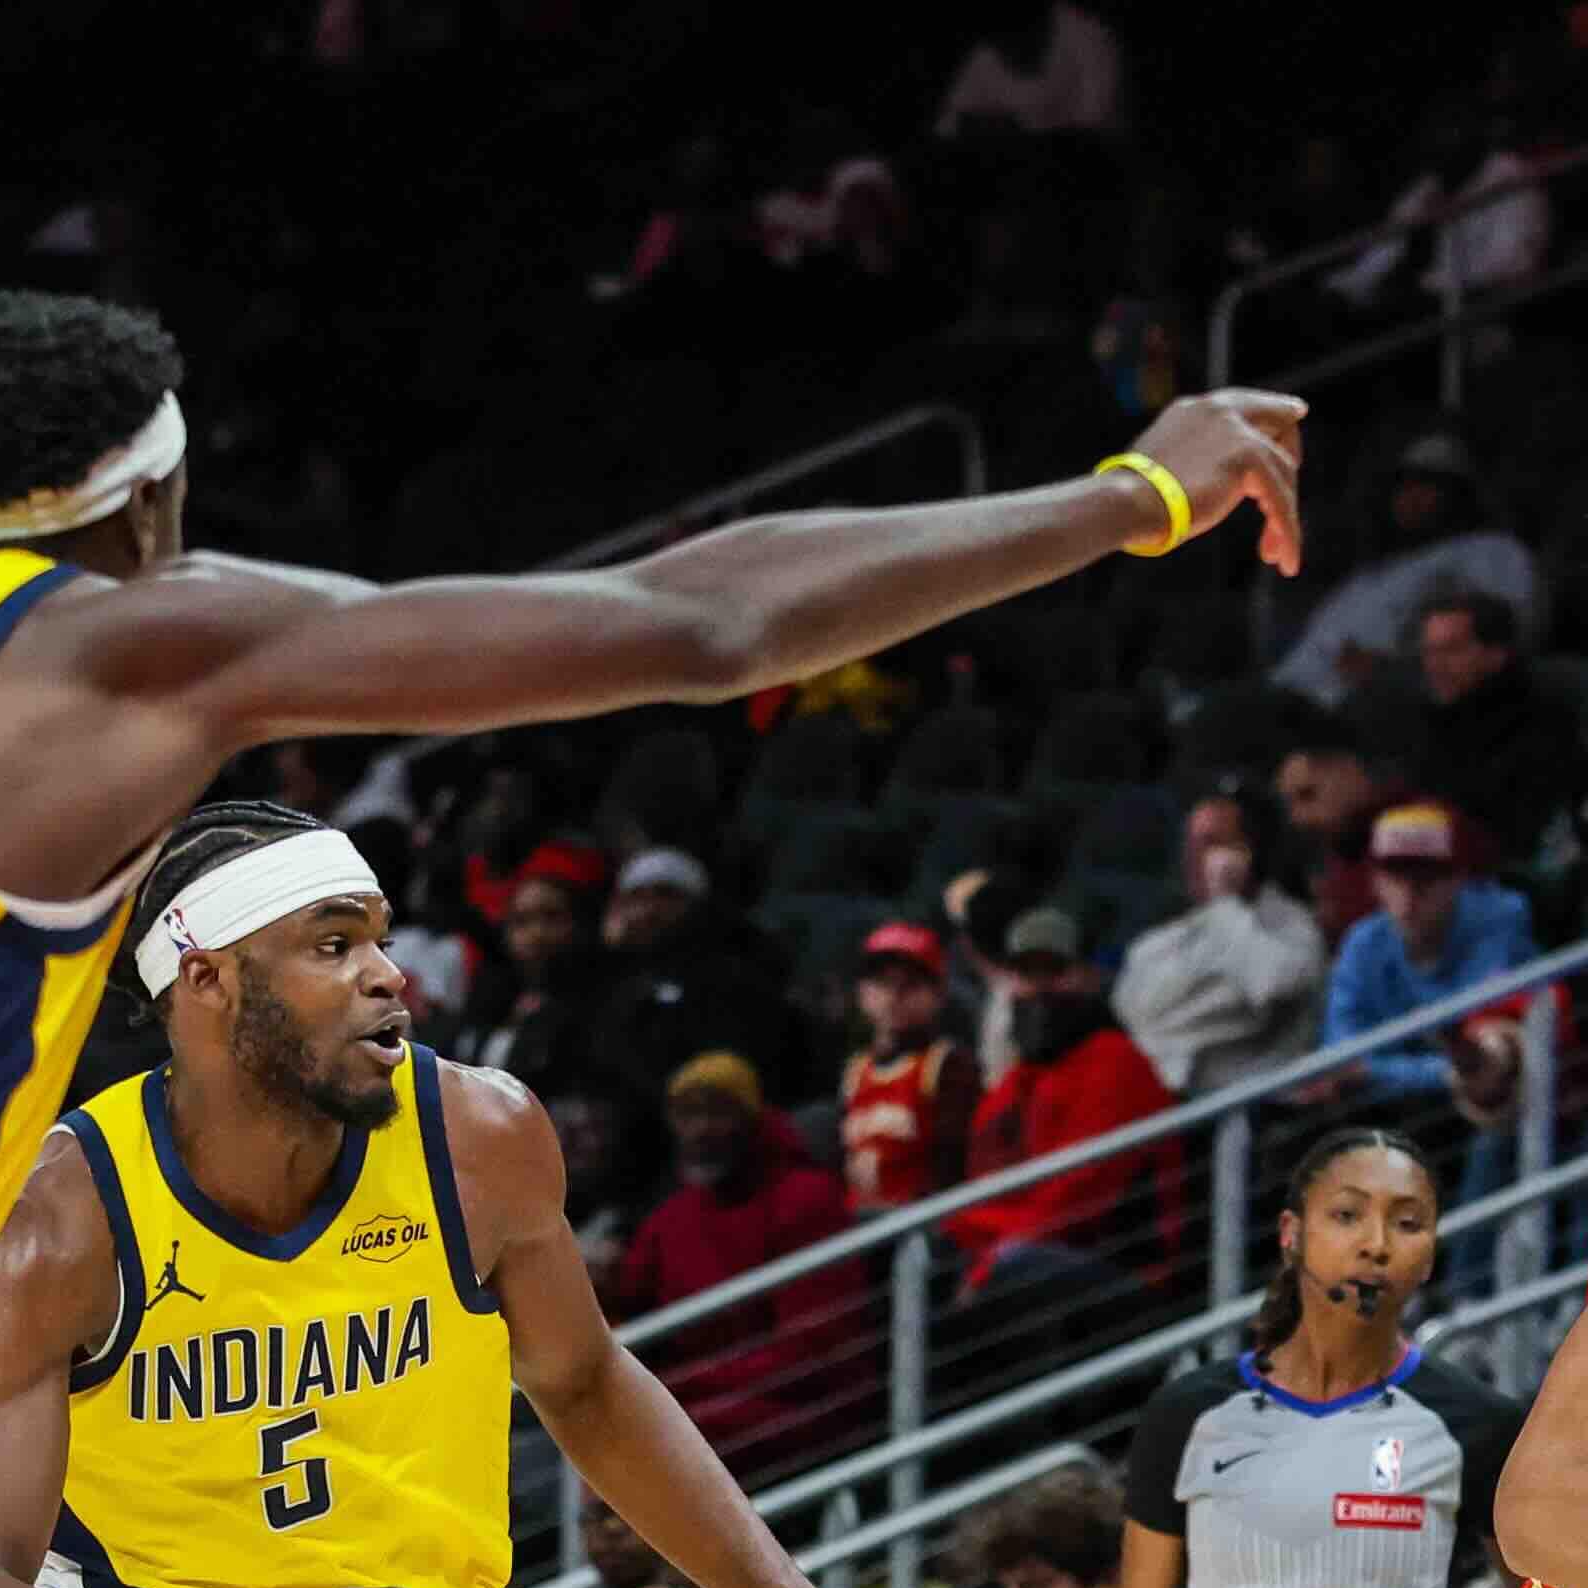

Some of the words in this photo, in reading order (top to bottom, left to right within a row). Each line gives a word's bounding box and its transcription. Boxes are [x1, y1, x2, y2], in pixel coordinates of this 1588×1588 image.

[341, 1227, 397, 1256] LUCAS
[401, 1222, 429, 1243] OIL
[129, 1295, 432, 1422] INDIANA
[258, 1408, 333, 1532] 5
